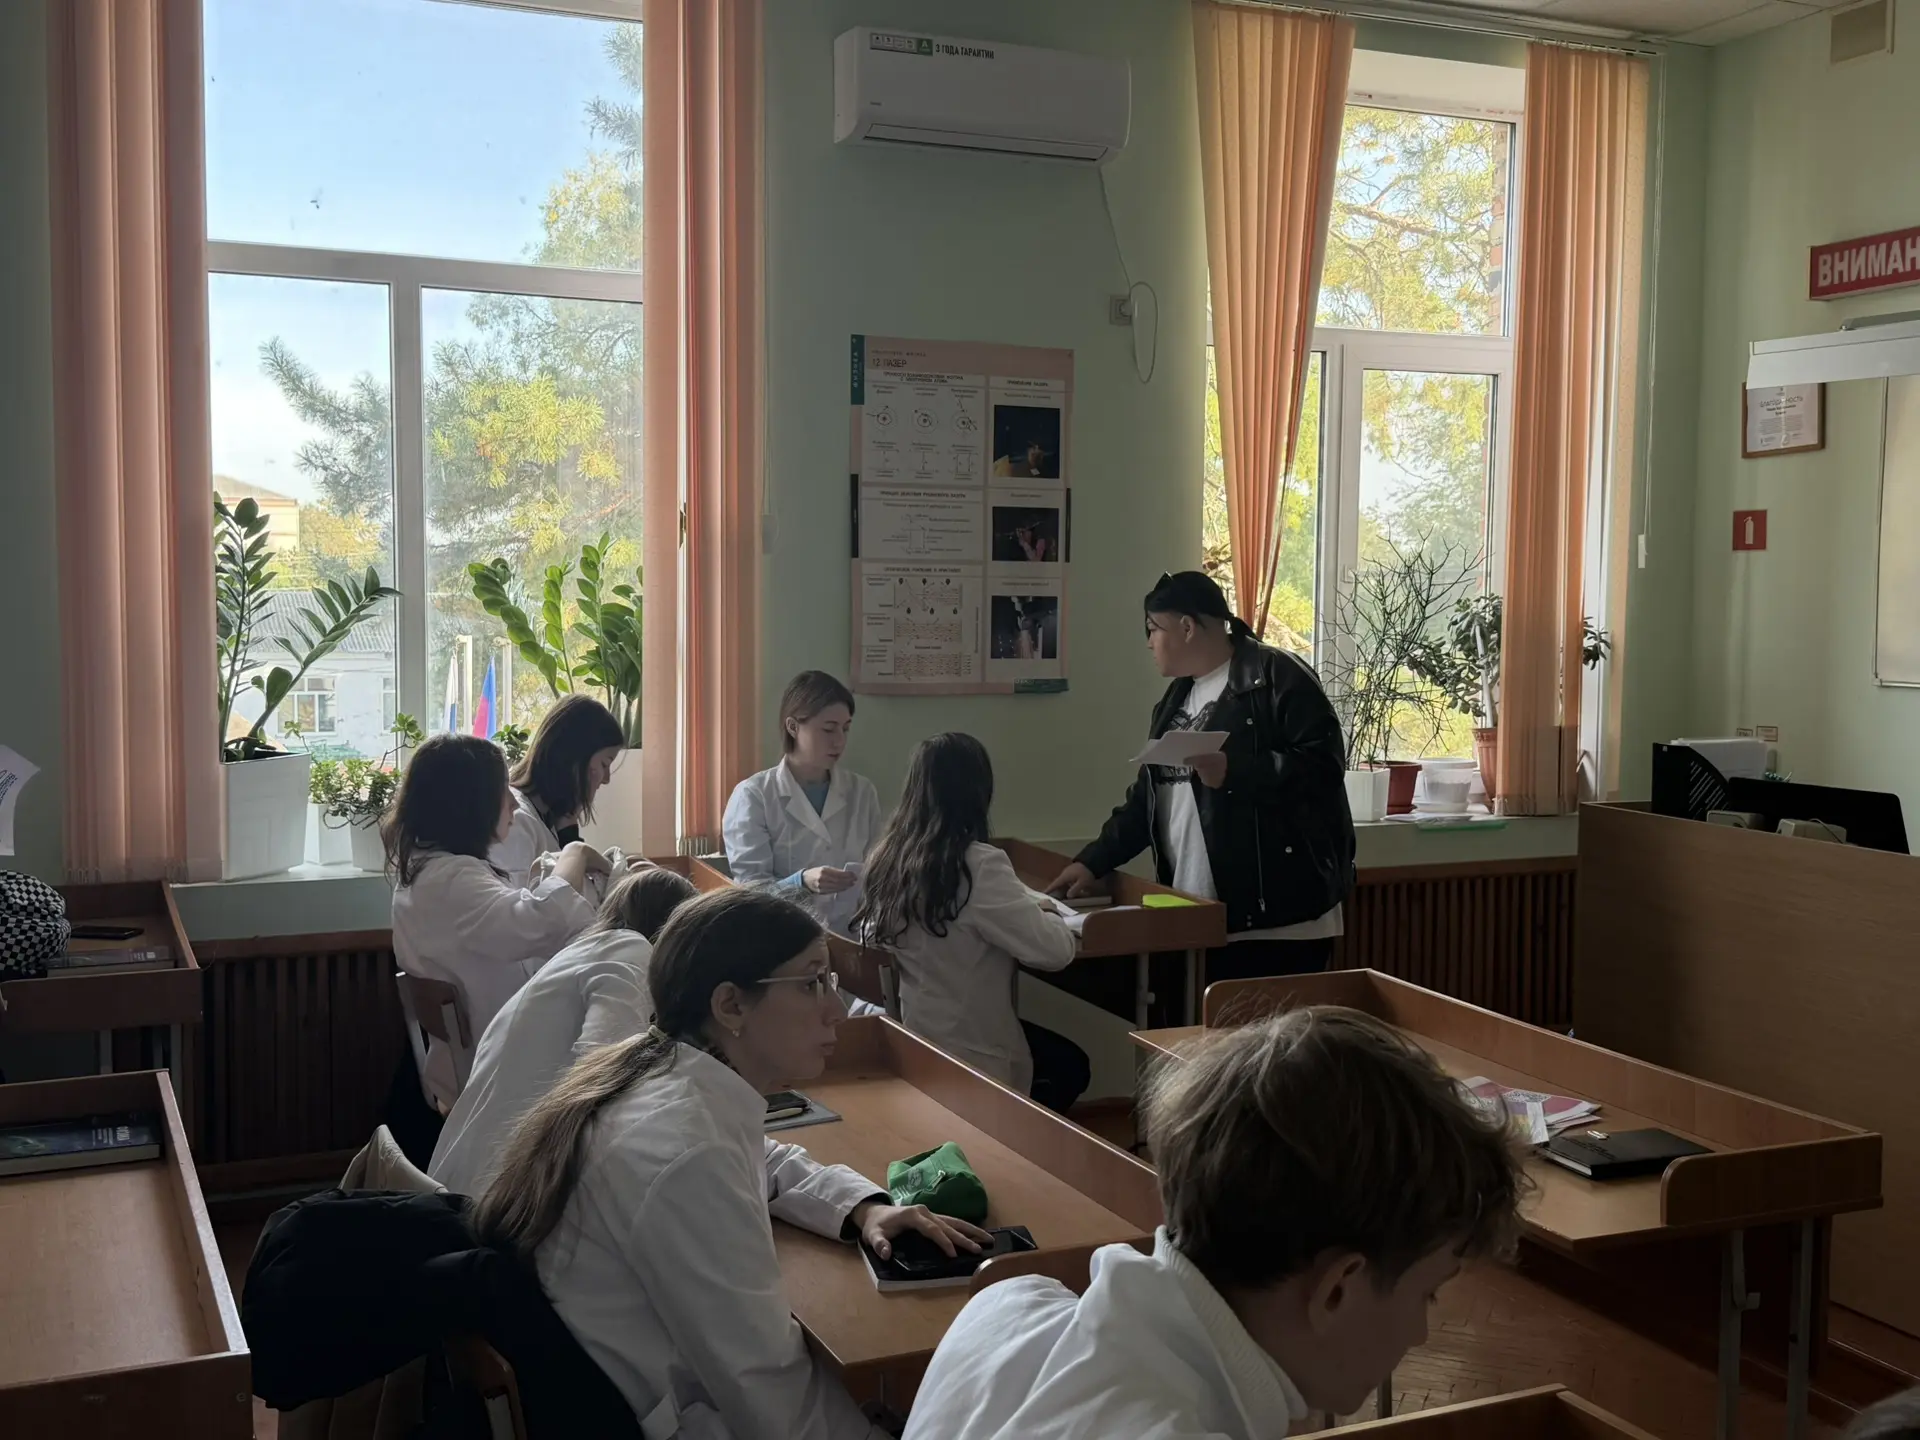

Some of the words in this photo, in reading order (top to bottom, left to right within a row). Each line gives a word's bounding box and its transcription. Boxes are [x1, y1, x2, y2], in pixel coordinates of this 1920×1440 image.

[935, 43, 940, 53] 3
[942, 44, 959, 56] ГОДА
[960, 46, 994, 60] ГАРАНТИИ
[1817, 236, 1920, 288] ВНИМАН
